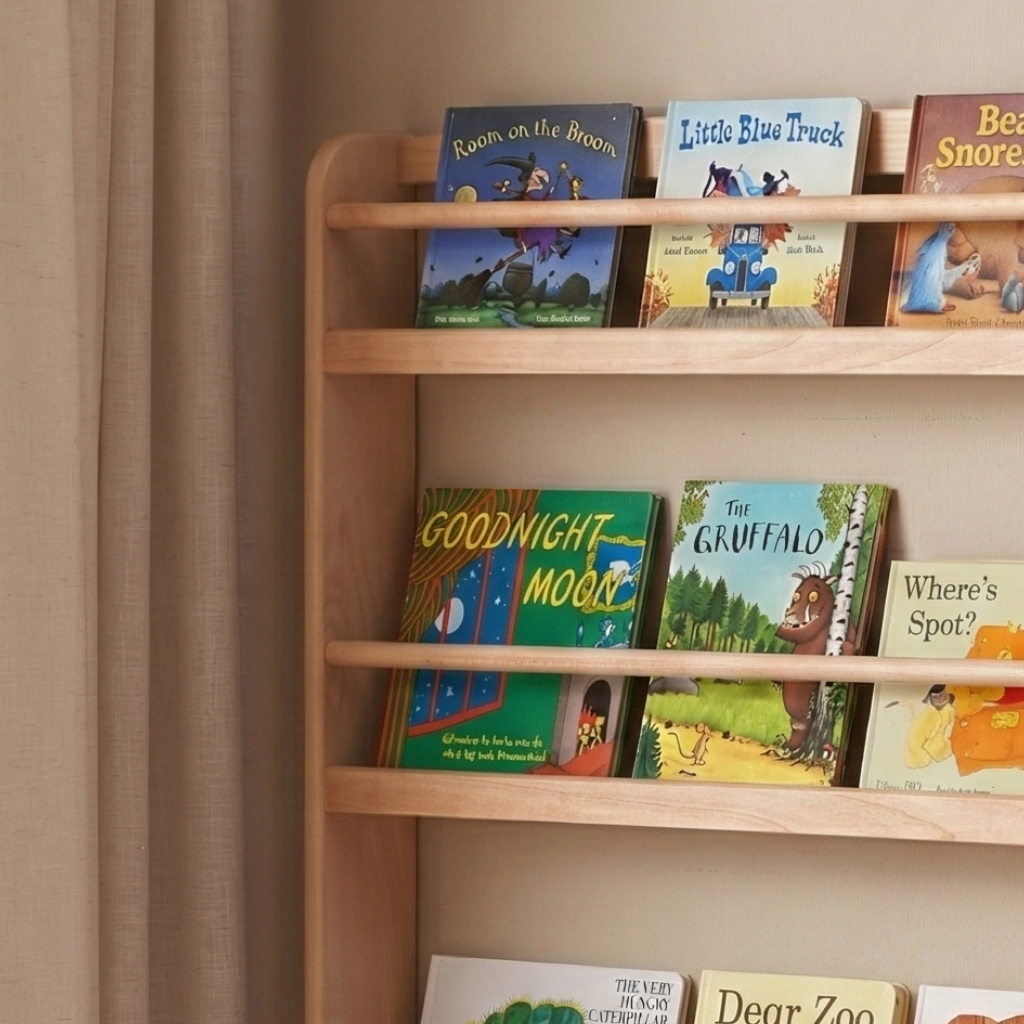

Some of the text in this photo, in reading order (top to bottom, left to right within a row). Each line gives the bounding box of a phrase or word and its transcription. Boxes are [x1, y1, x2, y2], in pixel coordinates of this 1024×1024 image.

[452, 118, 617, 161] Room on the Broom
[679, 112, 845, 150] Little Blue Truck
[725, 499, 752, 519] THE
[421, 511, 615, 551] GOODNIGHT
[693, 522, 824, 555] GRUFFALO
[522, 567, 627, 607] MOON
[904, 575, 998, 601] Where's
[908, 609, 977, 642] Spot?
[615, 979, 640, 994] THE
